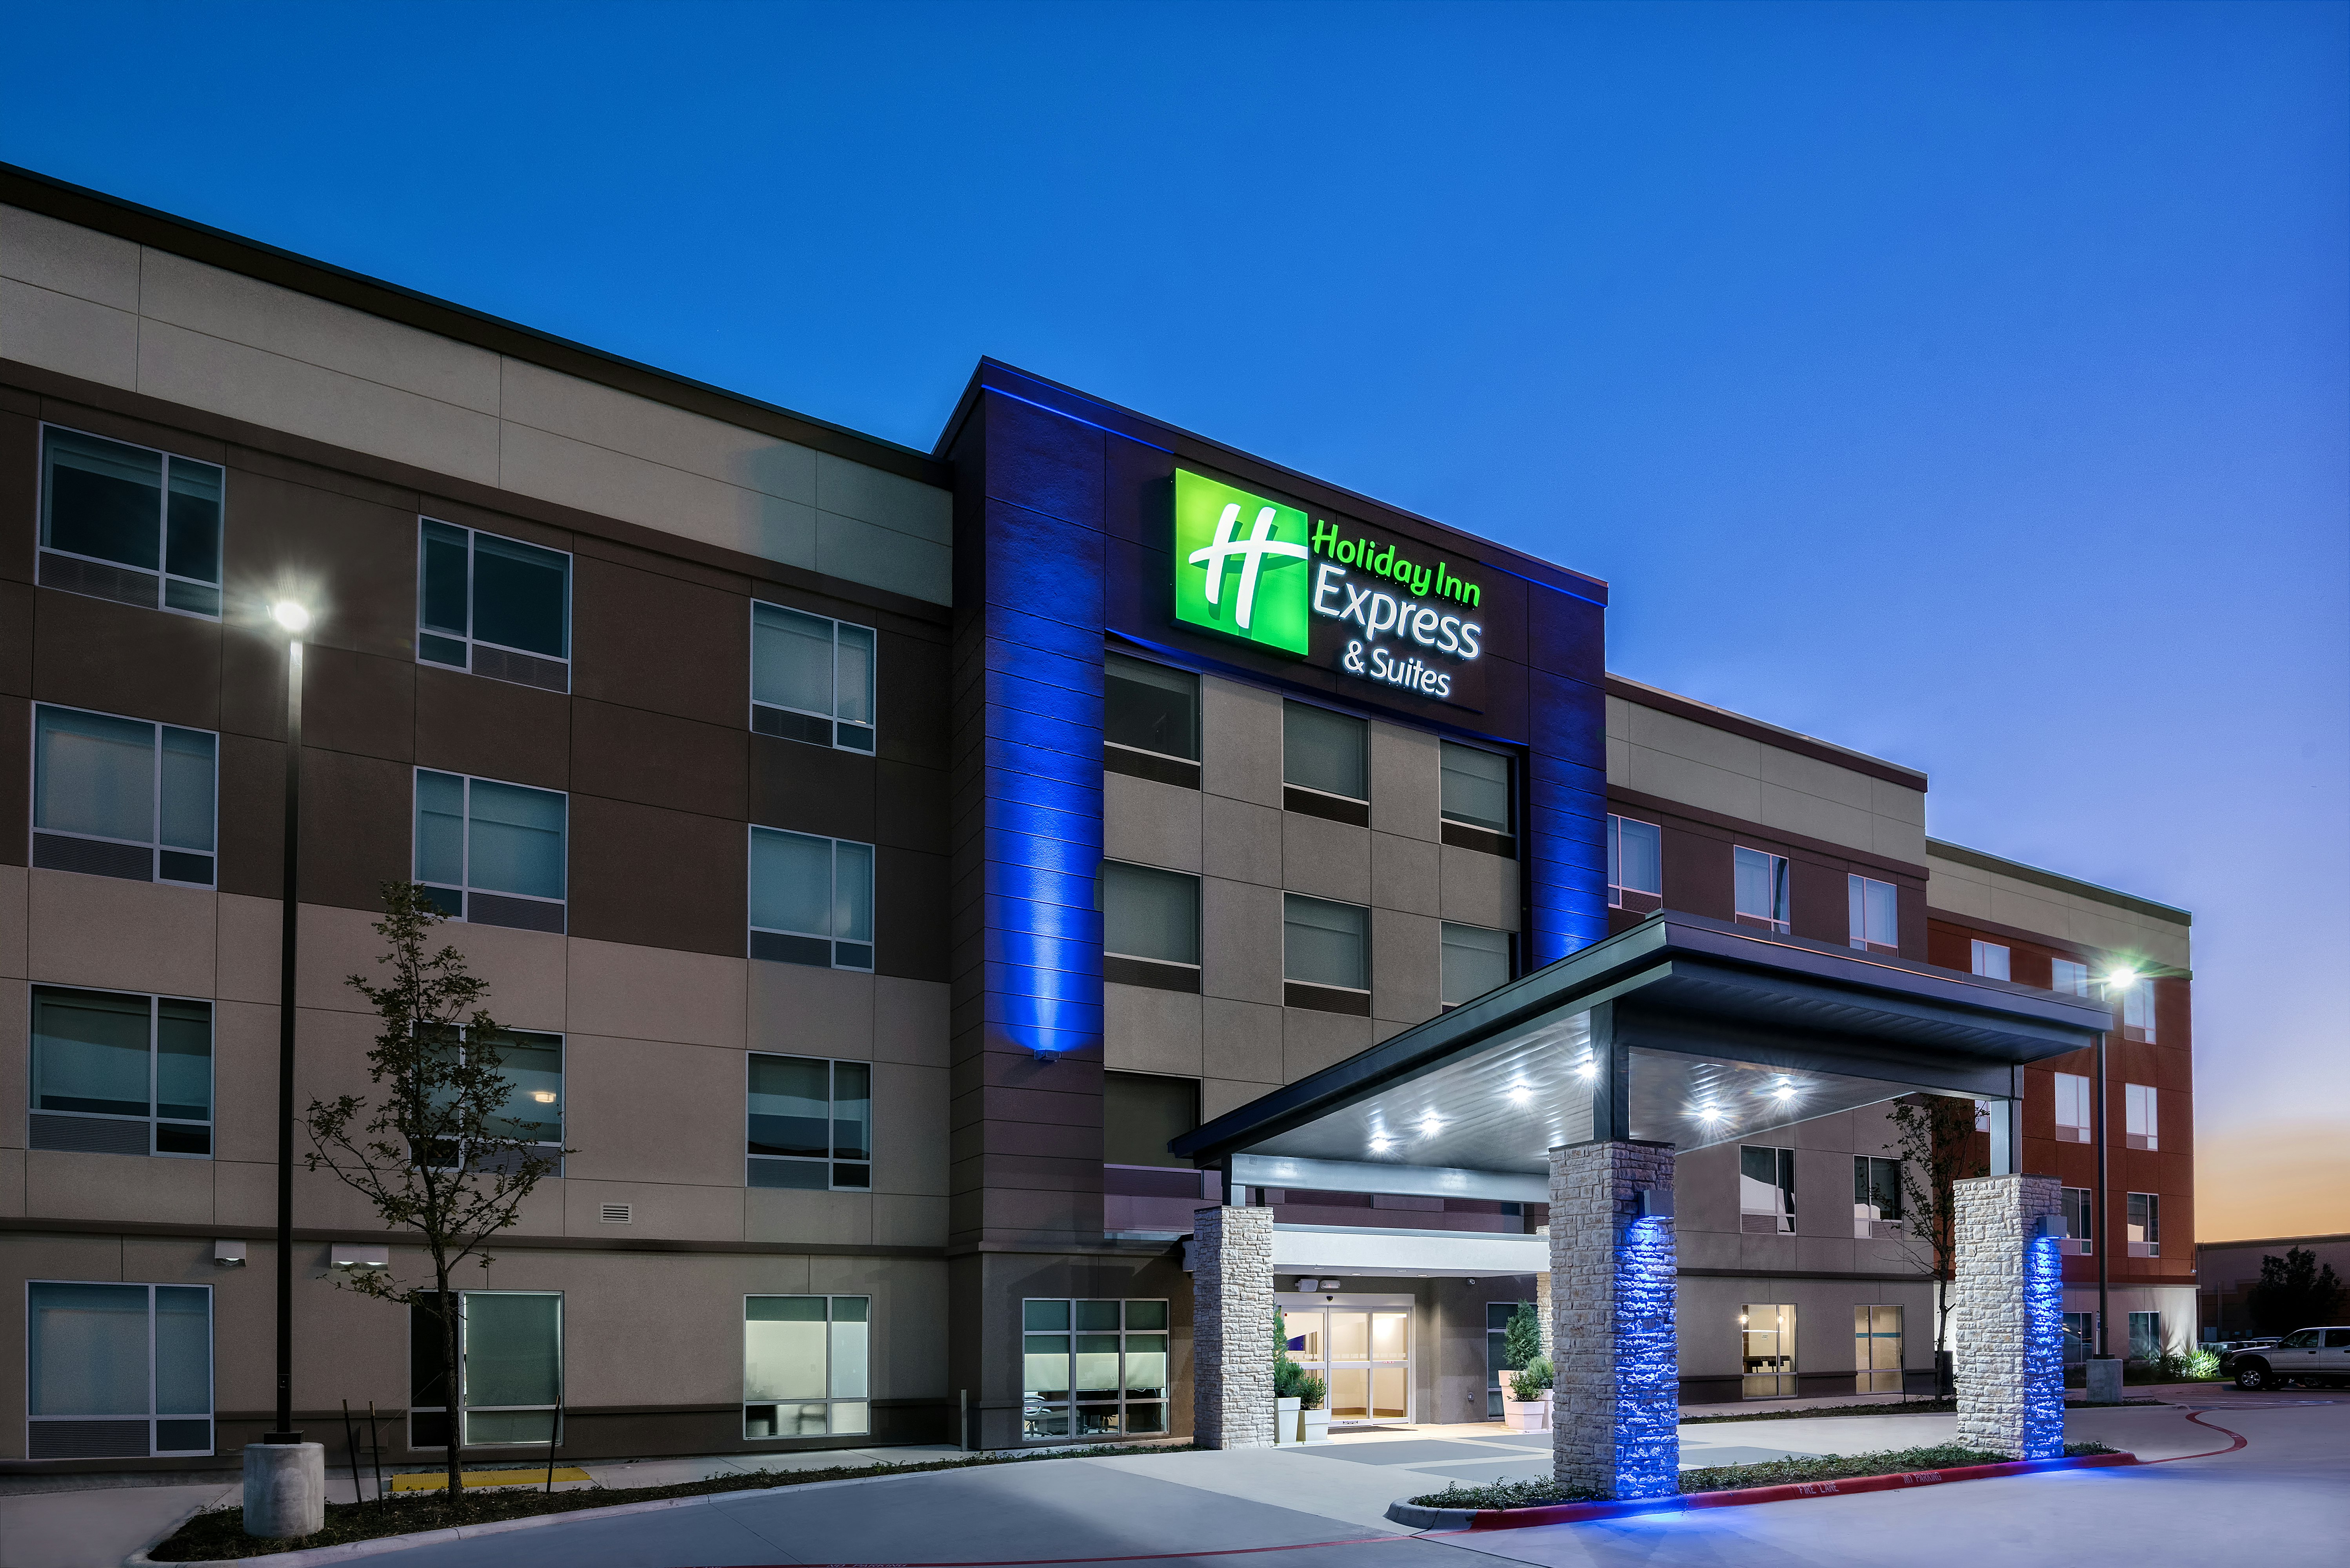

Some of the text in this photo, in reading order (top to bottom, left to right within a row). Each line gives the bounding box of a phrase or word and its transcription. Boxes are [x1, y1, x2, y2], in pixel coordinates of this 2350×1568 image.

[1311, 519, 1480, 607] Holiday Inn
[1314, 563, 1481, 658] Express
[1344, 640, 1450, 696] & Suites
[1797, 1482, 1839, 1494] FIRE LANE
[1901, 1472, 1942, 1483] NO PARKING
